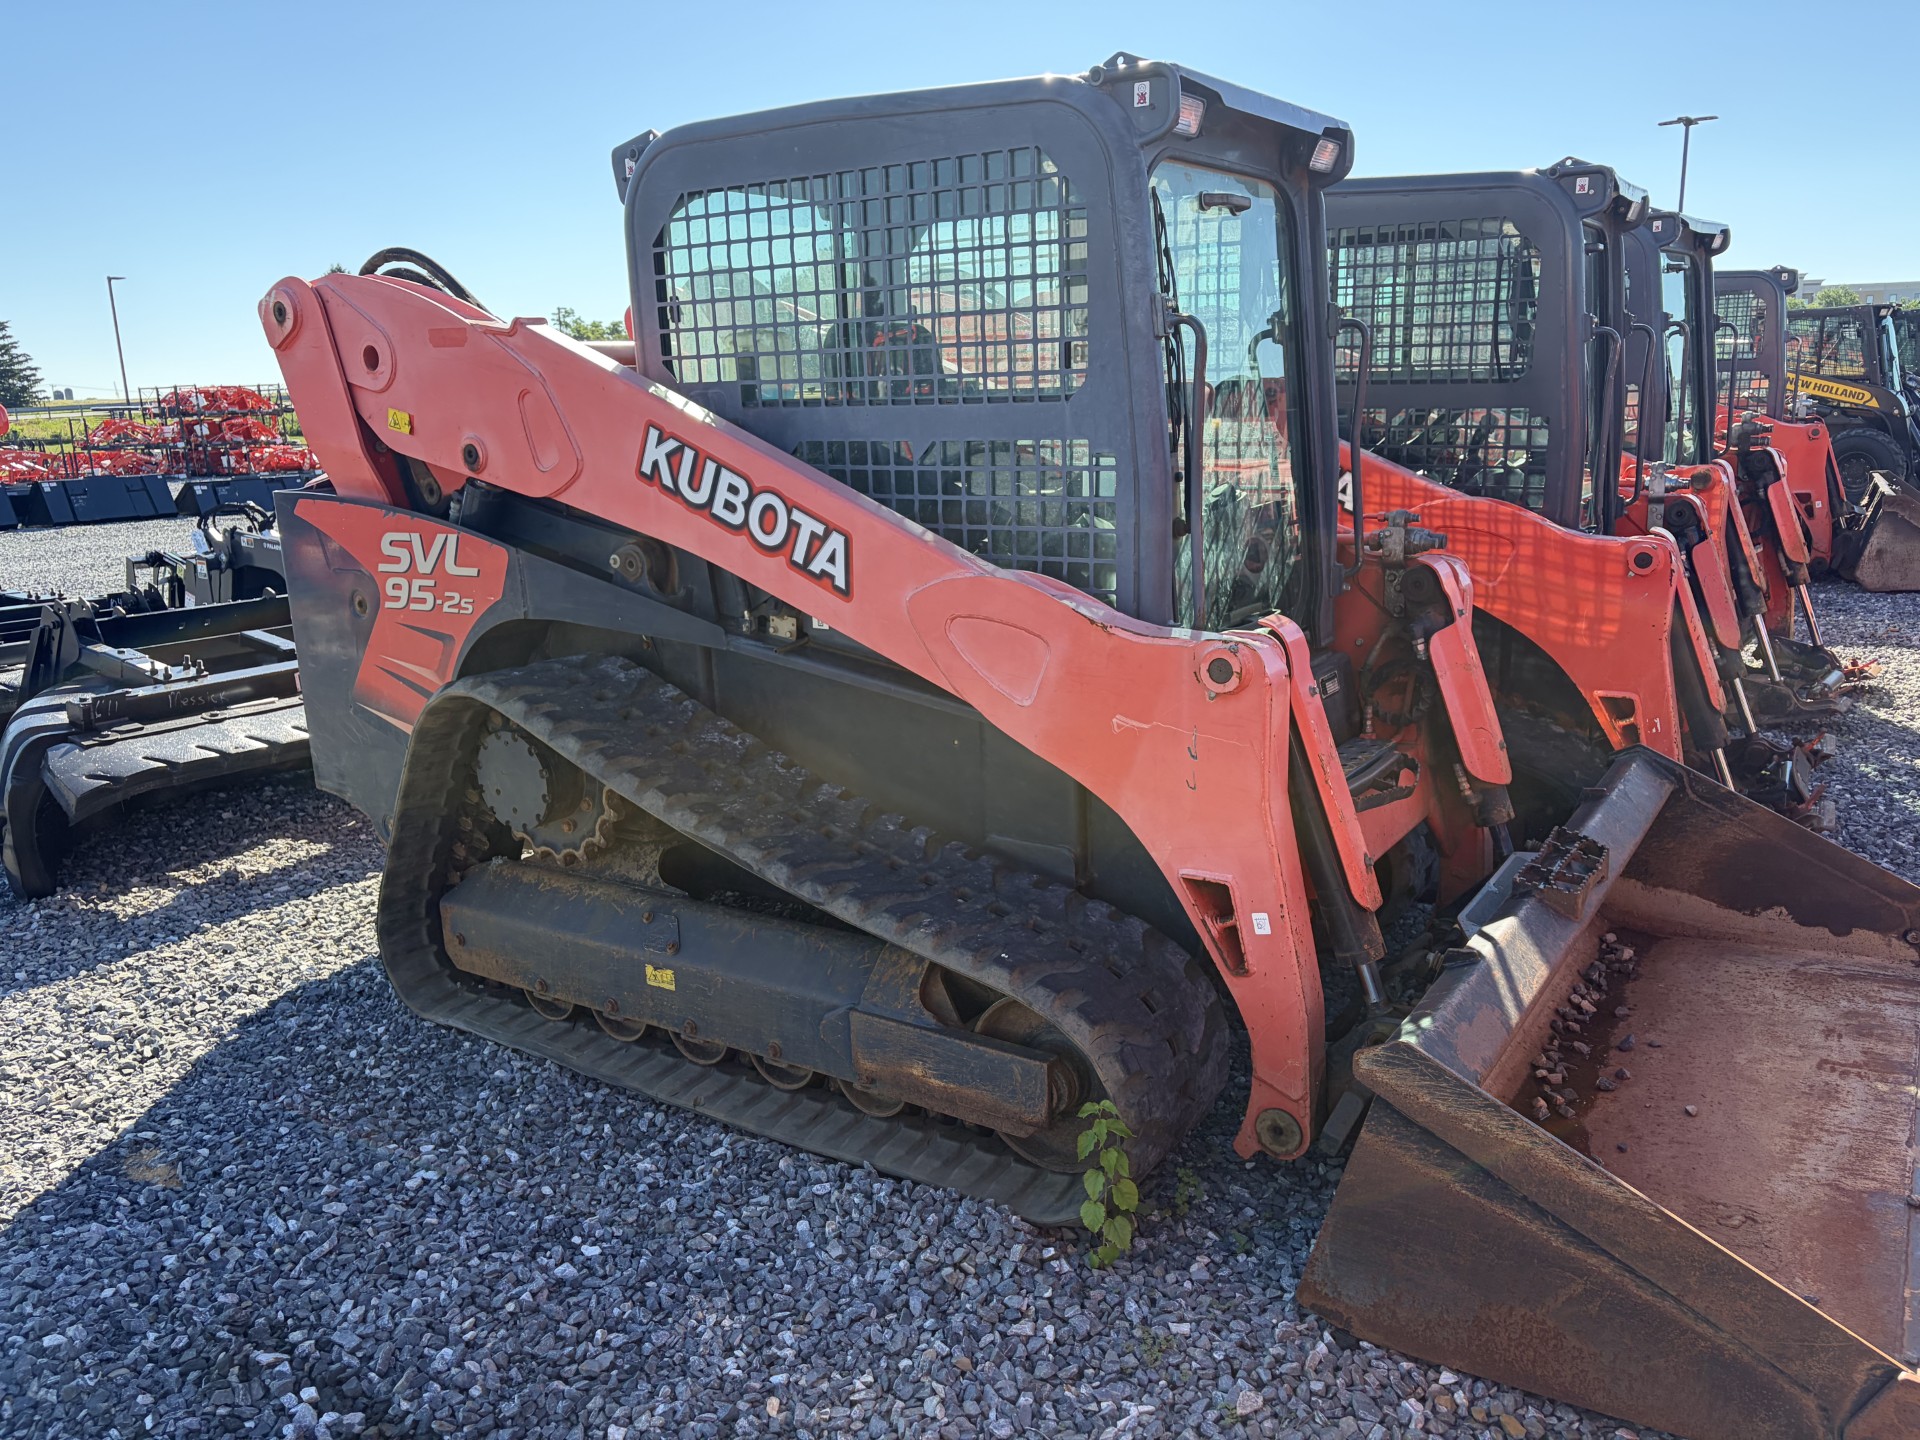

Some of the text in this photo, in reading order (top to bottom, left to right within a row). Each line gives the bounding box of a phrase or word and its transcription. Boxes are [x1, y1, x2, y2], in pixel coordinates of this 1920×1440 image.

[1786, 376, 1866, 401] NW HOLLAND
[639, 425, 847, 591] KUBOTA
[377, 531, 480, 577] SVL
